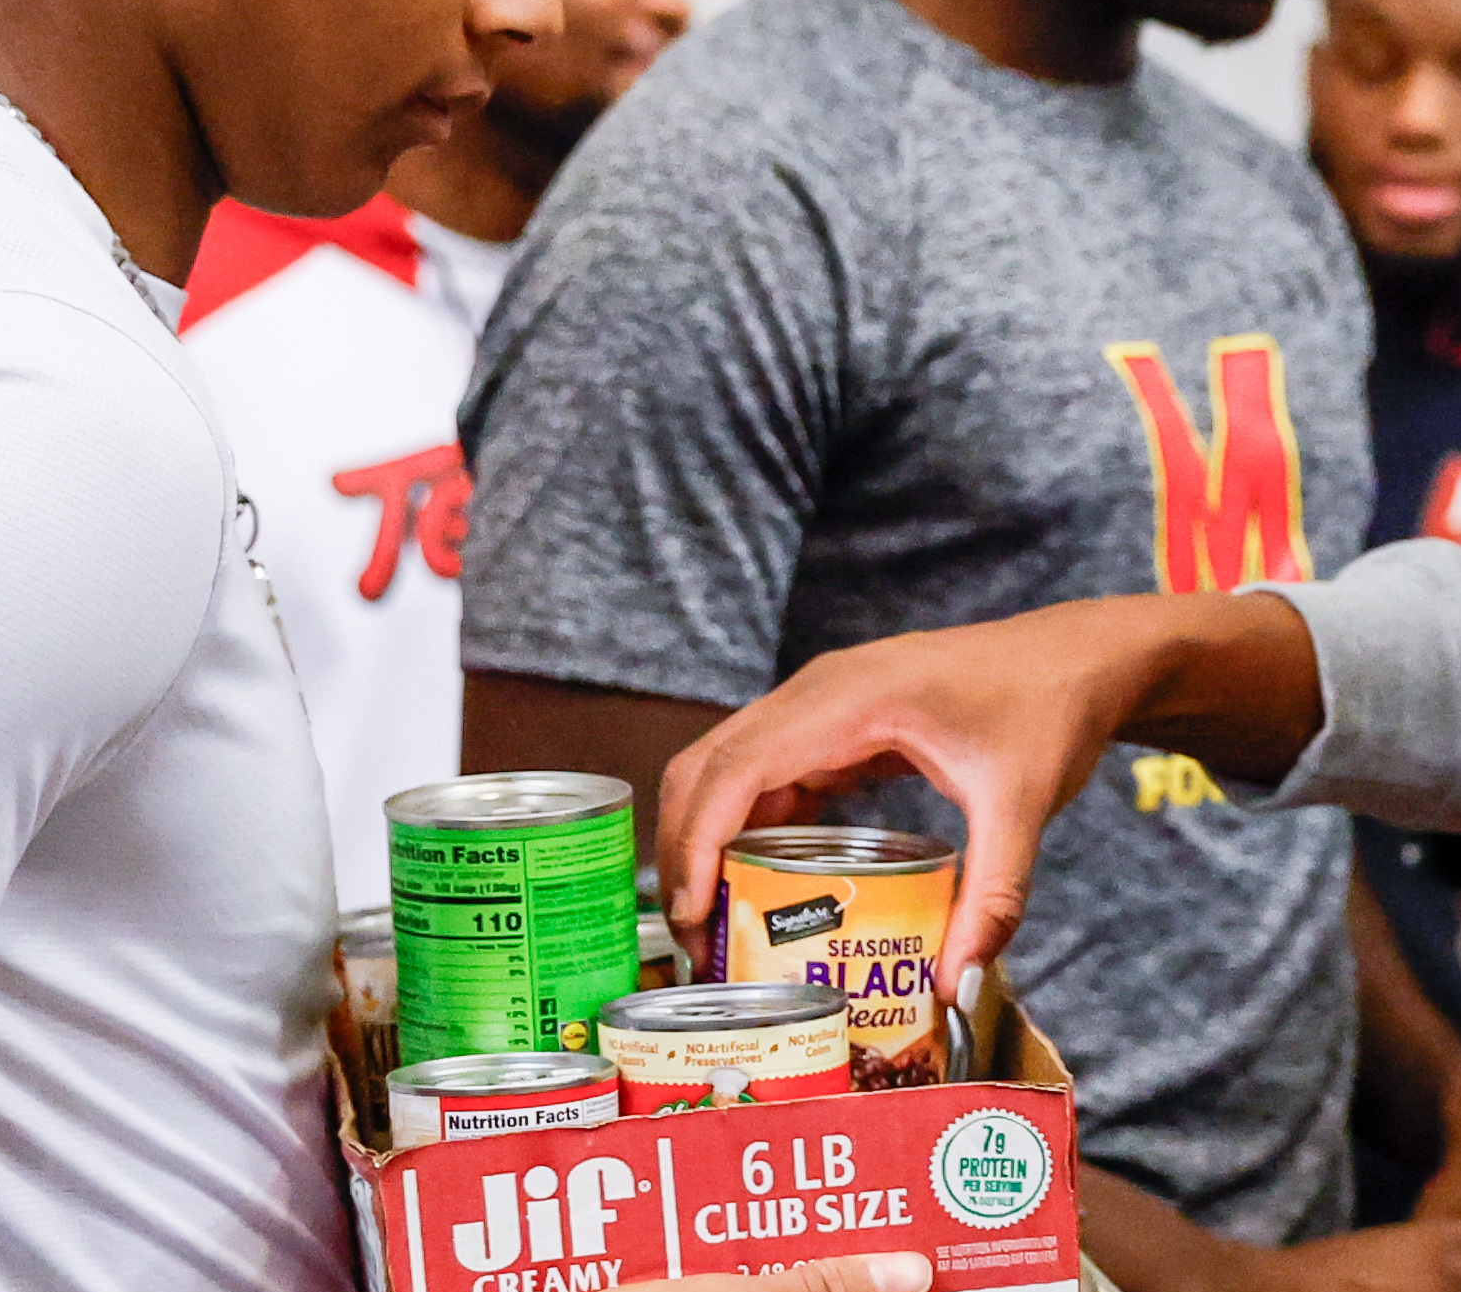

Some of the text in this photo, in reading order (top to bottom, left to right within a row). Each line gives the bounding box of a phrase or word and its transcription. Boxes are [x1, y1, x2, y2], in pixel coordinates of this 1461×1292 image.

[1103, 333, 1314, 595] M
[452, 845, 520, 864] Facts
[472, 912, 522, 932] 110
[827, 935, 924, 958] SEASONED
[806, 956, 937, 1000] BLACK
[686, 1038, 760, 1054] NO Artificial
[788, 1034, 806, 1047] NO
[684, 1053, 763, 1067] Preservatives
[447, 1105, 580, 1131] Nutrition Facts
[982, 1124, 1006, 1154] 7g
[741, 1133, 857, 1196] 6 LB
[959, 1157, 1028, 1180] PROTEIN
[451, 1156, 637, 1273] Jif
[694, 1187, 914, 1245] CLUB SIZE
